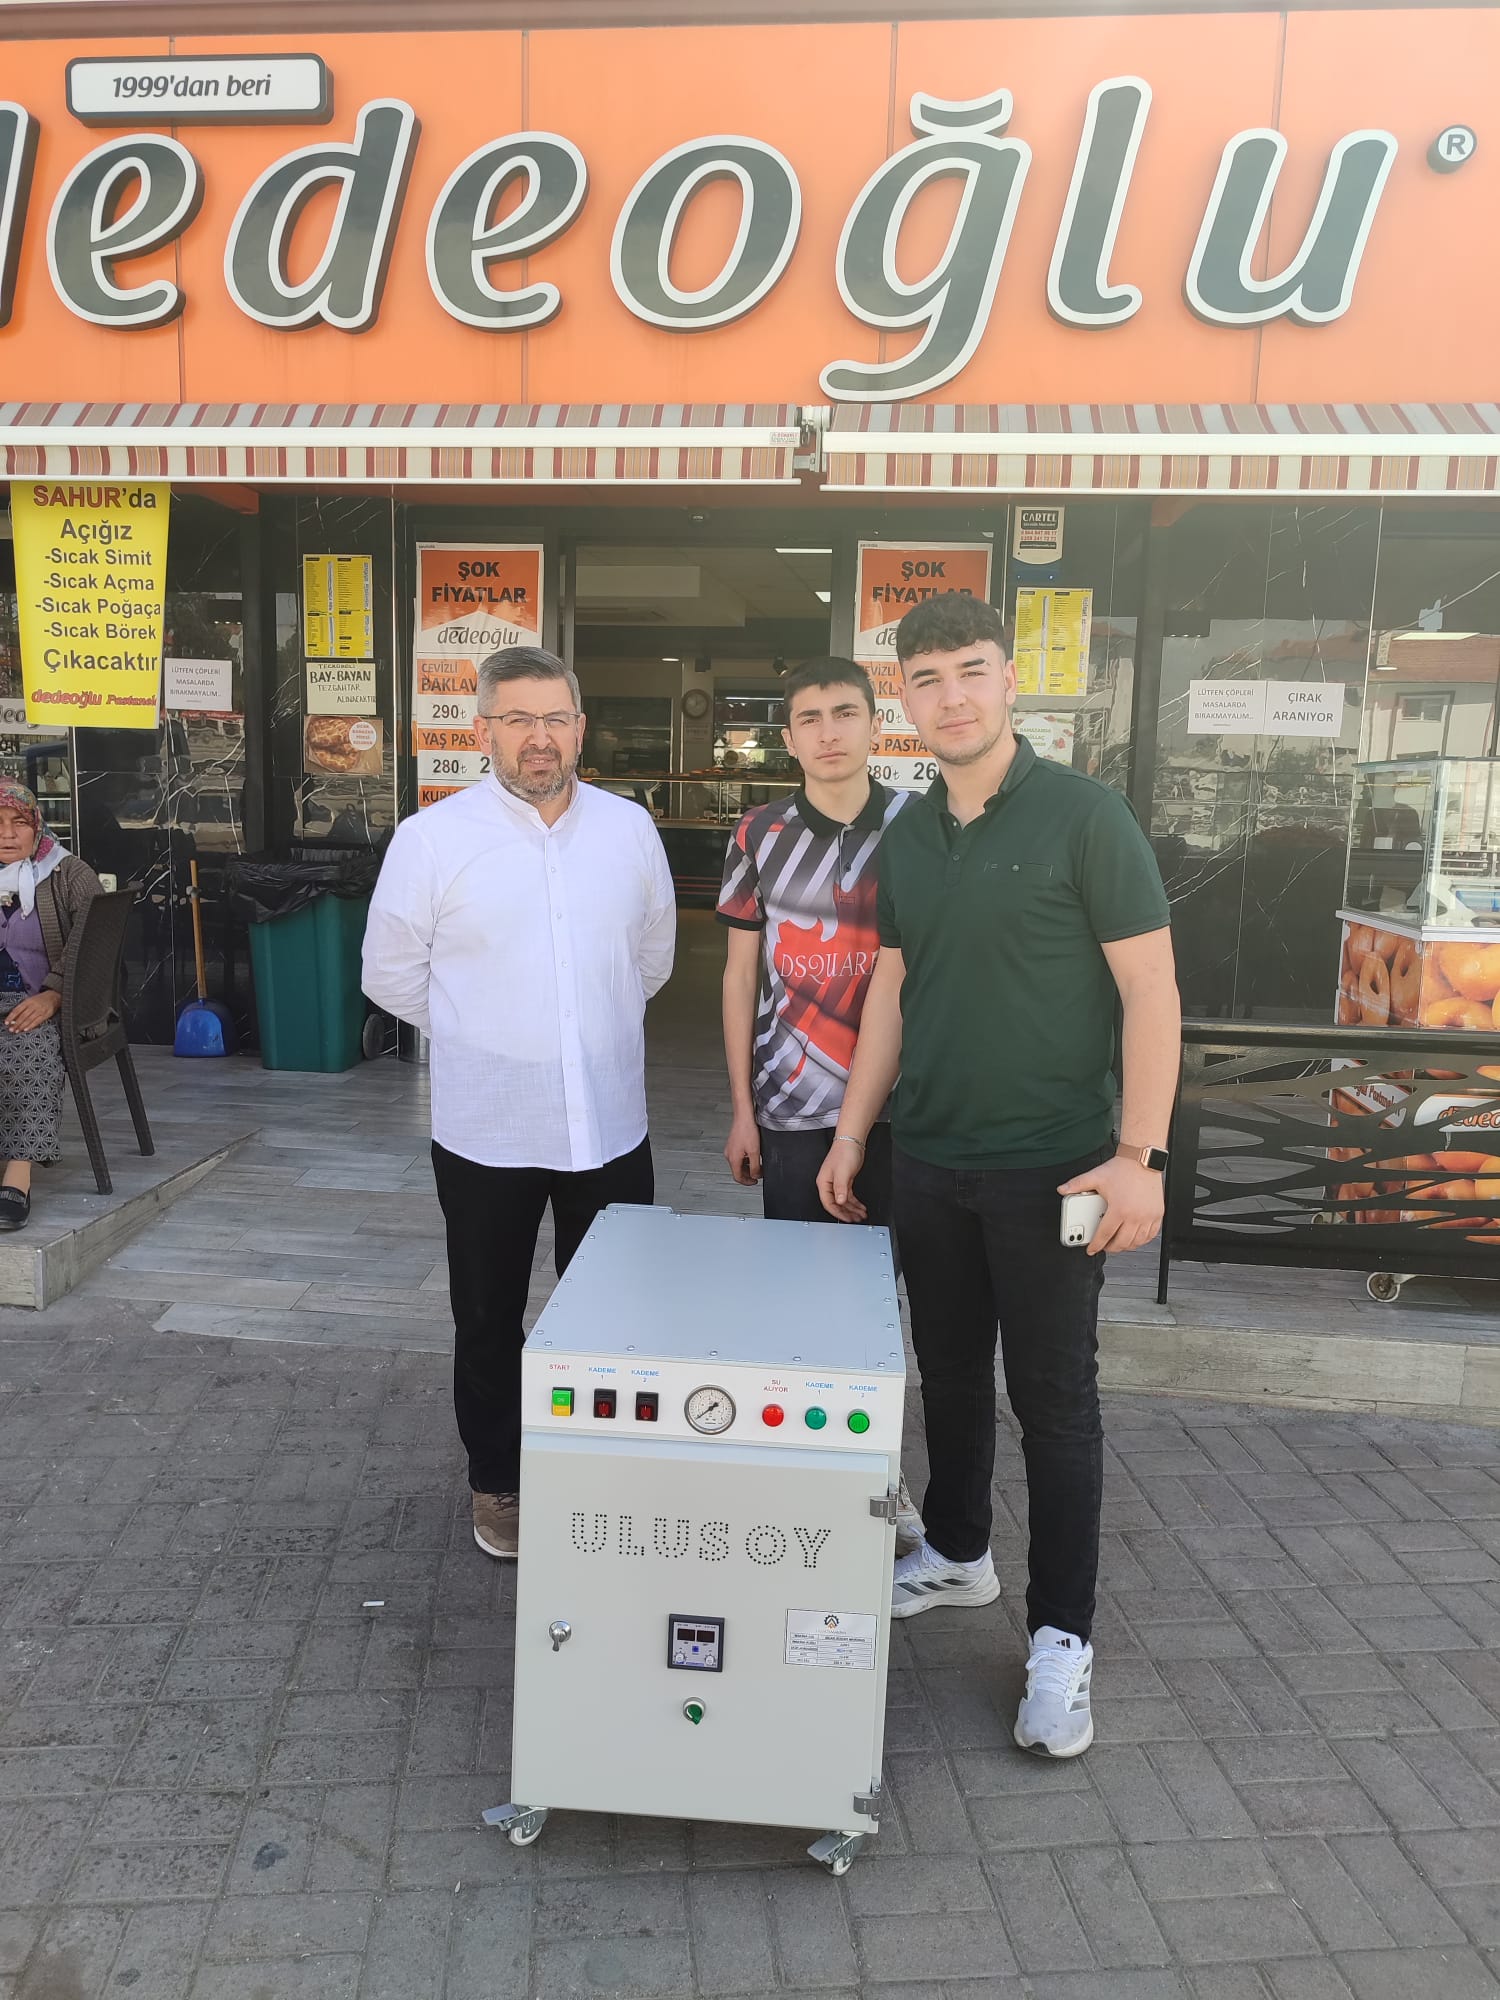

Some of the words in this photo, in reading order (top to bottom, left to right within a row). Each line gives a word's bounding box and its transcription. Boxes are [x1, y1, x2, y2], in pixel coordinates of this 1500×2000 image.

[111, 73, 220, 98] 1999'dan
[226, 73, 272, 98] beri
[33, 485, 157, 509] SAHUR'da
[1022, 512, 1057, 522] CARTEL
[60, 518, 133, 545] Açığız
[105, 549, 152, 566] Simit
[458, 561, 501, 581] ŞOK
[901, 561, 946, 581] ŞOK
[103, 574, 155, 593] Açma
[431, 583, 528, 604] FİYATLAR
[872, 583, 973, 604] FİYAT
[97, 598, 161, 620] Poğaça
[105, 623, 157, 641] Börek
[437, 626, 520, 650] dedeoğlu
[43, 648, 159, 674] Çıkacaktır
[421, 661, 458, 674] CEVİZLİ
[176, 678, 215, 687] MASALARDA
[309, 670, 372, 684] BAY-BAYAN
[421, 677, 478, 692] BAKLAV
[31, 688, 103, 709] dedeoğlu
[1197, 688, 1224, 697] LÜTFEN
[1226, 688, 1254, 698] ÇÖPLERİ
[1287, 692, 1323, 705] ÇIRAK
[1272, 711, 1334, 723] ARANIYOR
[422, 732, 447, 748] YAŞ
[451, 733, 476, 747] PAS
[884, 738, 928, 753] PASTA
[913, 761, 937, 781] 26
[422, 790, 452, 803] KUR
[549, 1363, 570, 1371] START
[631, 1369, 660, 1377] KADEME
[805, 1381, 834, 1390] KADEME
[848, 1384, 878, 1392] KADEME
[571, 1511, 832, 1569] ULUSOY
